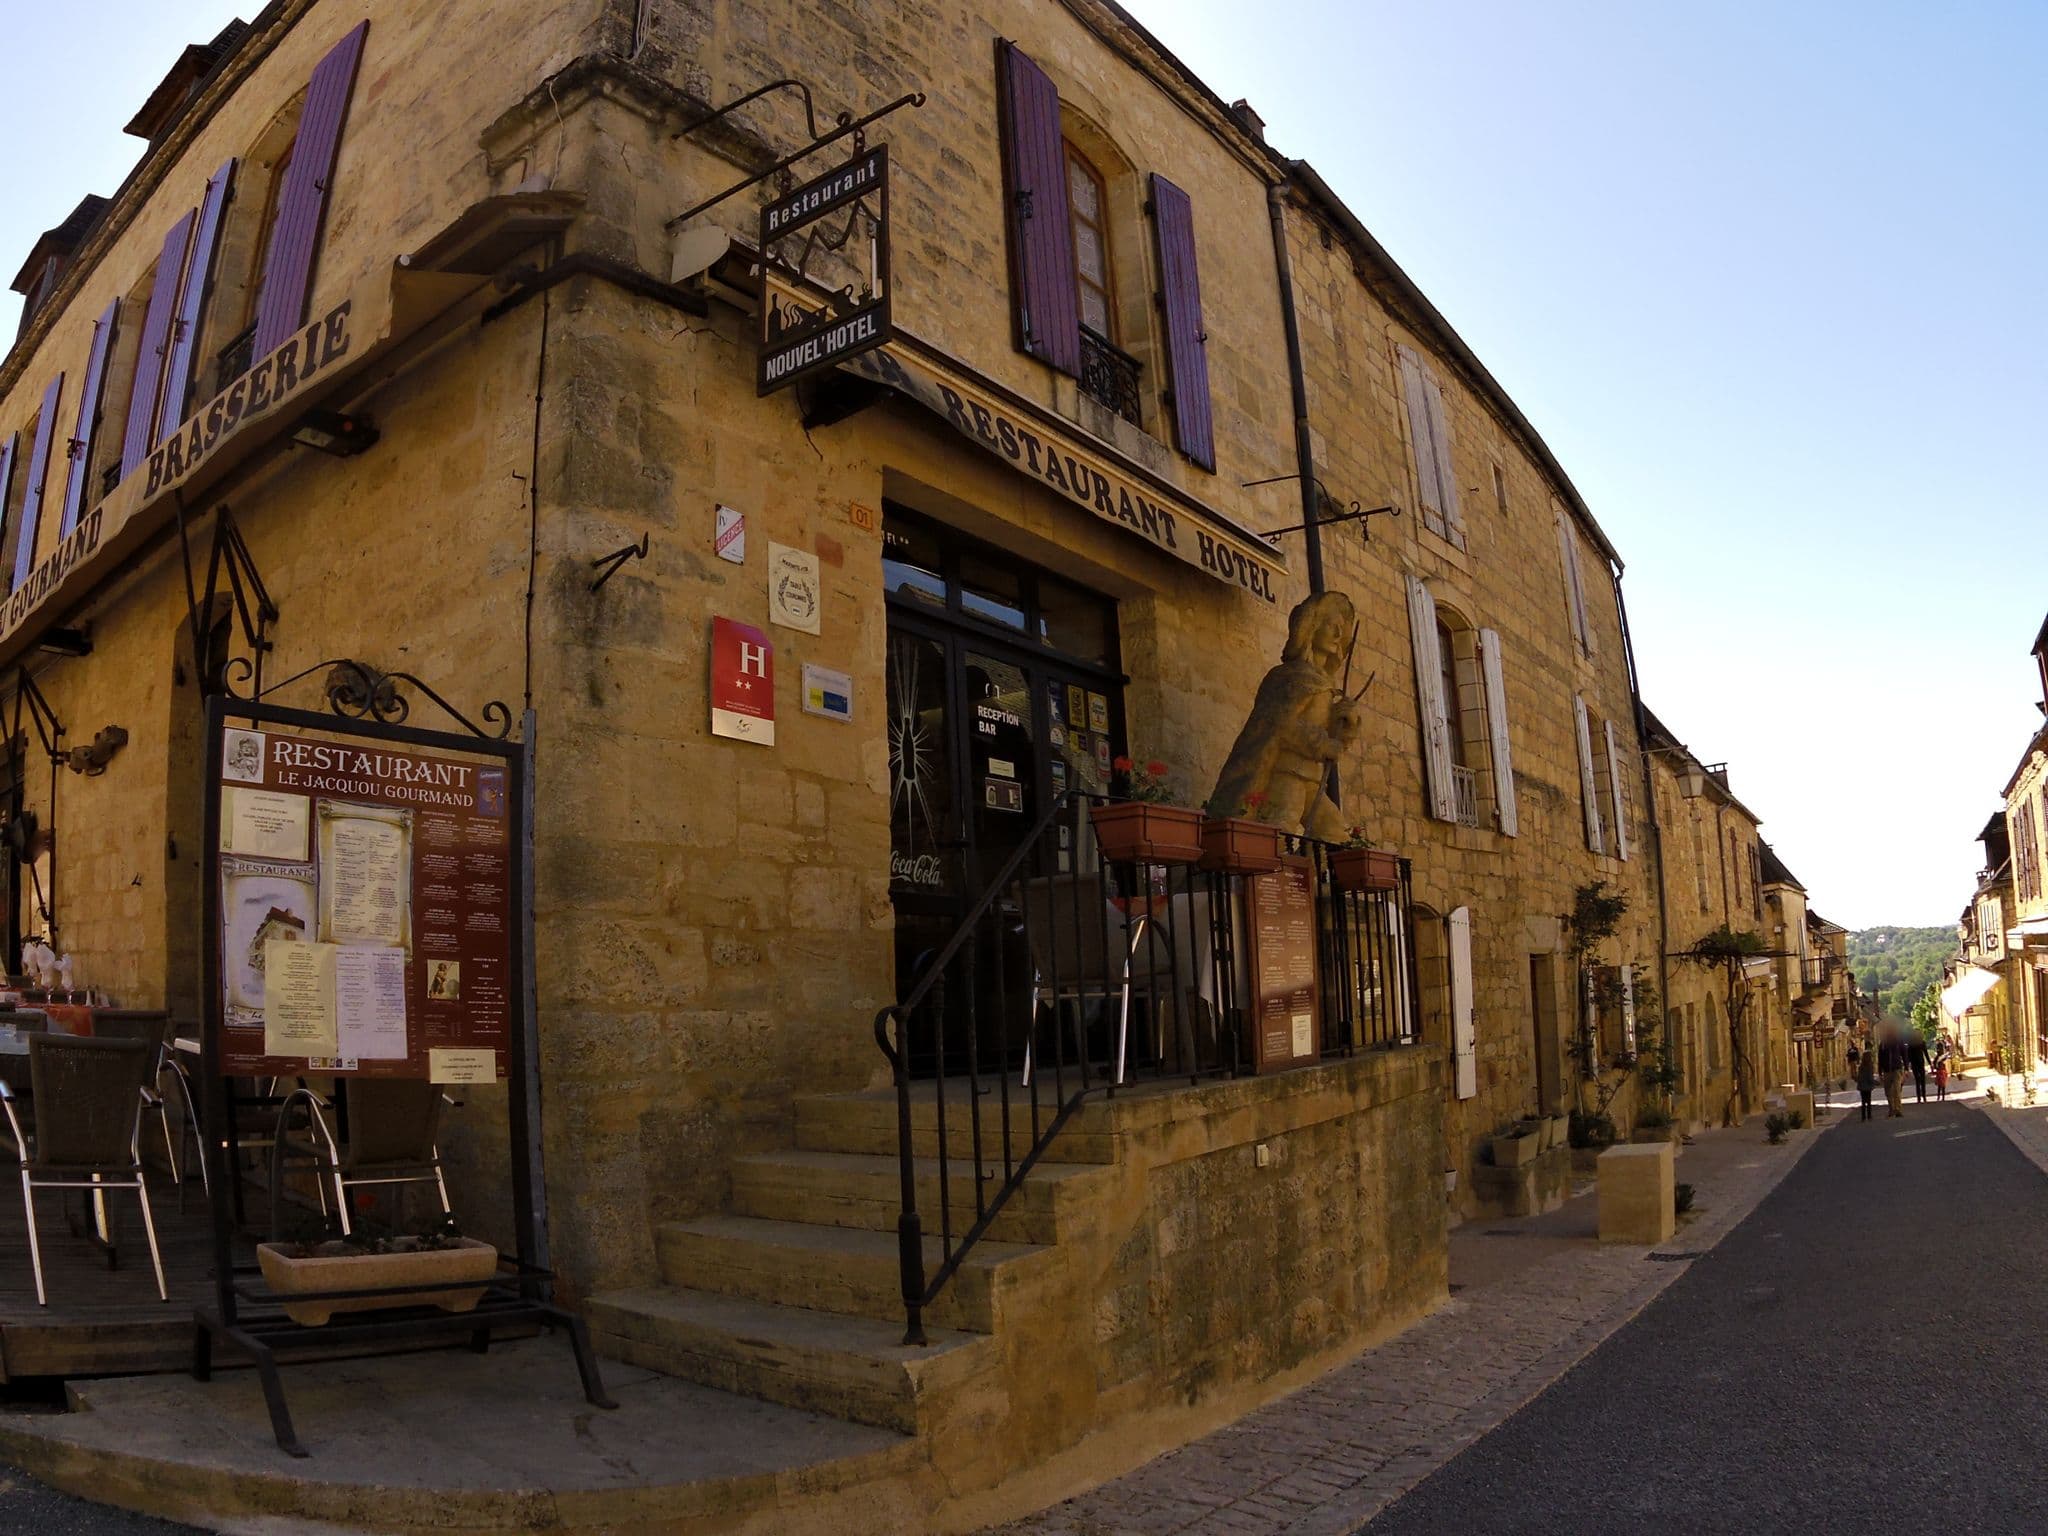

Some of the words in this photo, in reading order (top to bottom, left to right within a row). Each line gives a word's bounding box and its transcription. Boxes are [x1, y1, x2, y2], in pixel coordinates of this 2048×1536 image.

[769, 159, 877, 230] Restaurant
[766, 314, 877, 381] NOUVEL'HOTEL
[143, 300, 350, 499] BRASSERIE
[936, 382, 1177, 549] RESTAURANT
[1196, 529, 1276, 604] HOTEL
[716, 521, 744, 552] LICENCE
[10, 507, 103, 627] GOURMAND
[740, 640, 767, 678] H
[977, 705, 1019, 727] RECEPTION
[978, 720, 997, 736] BAR
[273, 741, 471, 788] RESTAURANT
[278, 771, 300, 786] LE
[303, 774, 381, 797] JACQUOU
[384, 785, 474, 807] GOURMAND
[238, 862, 309, 877] RESTAURANT
[889, 849, 942, 885] Coca-Cola
